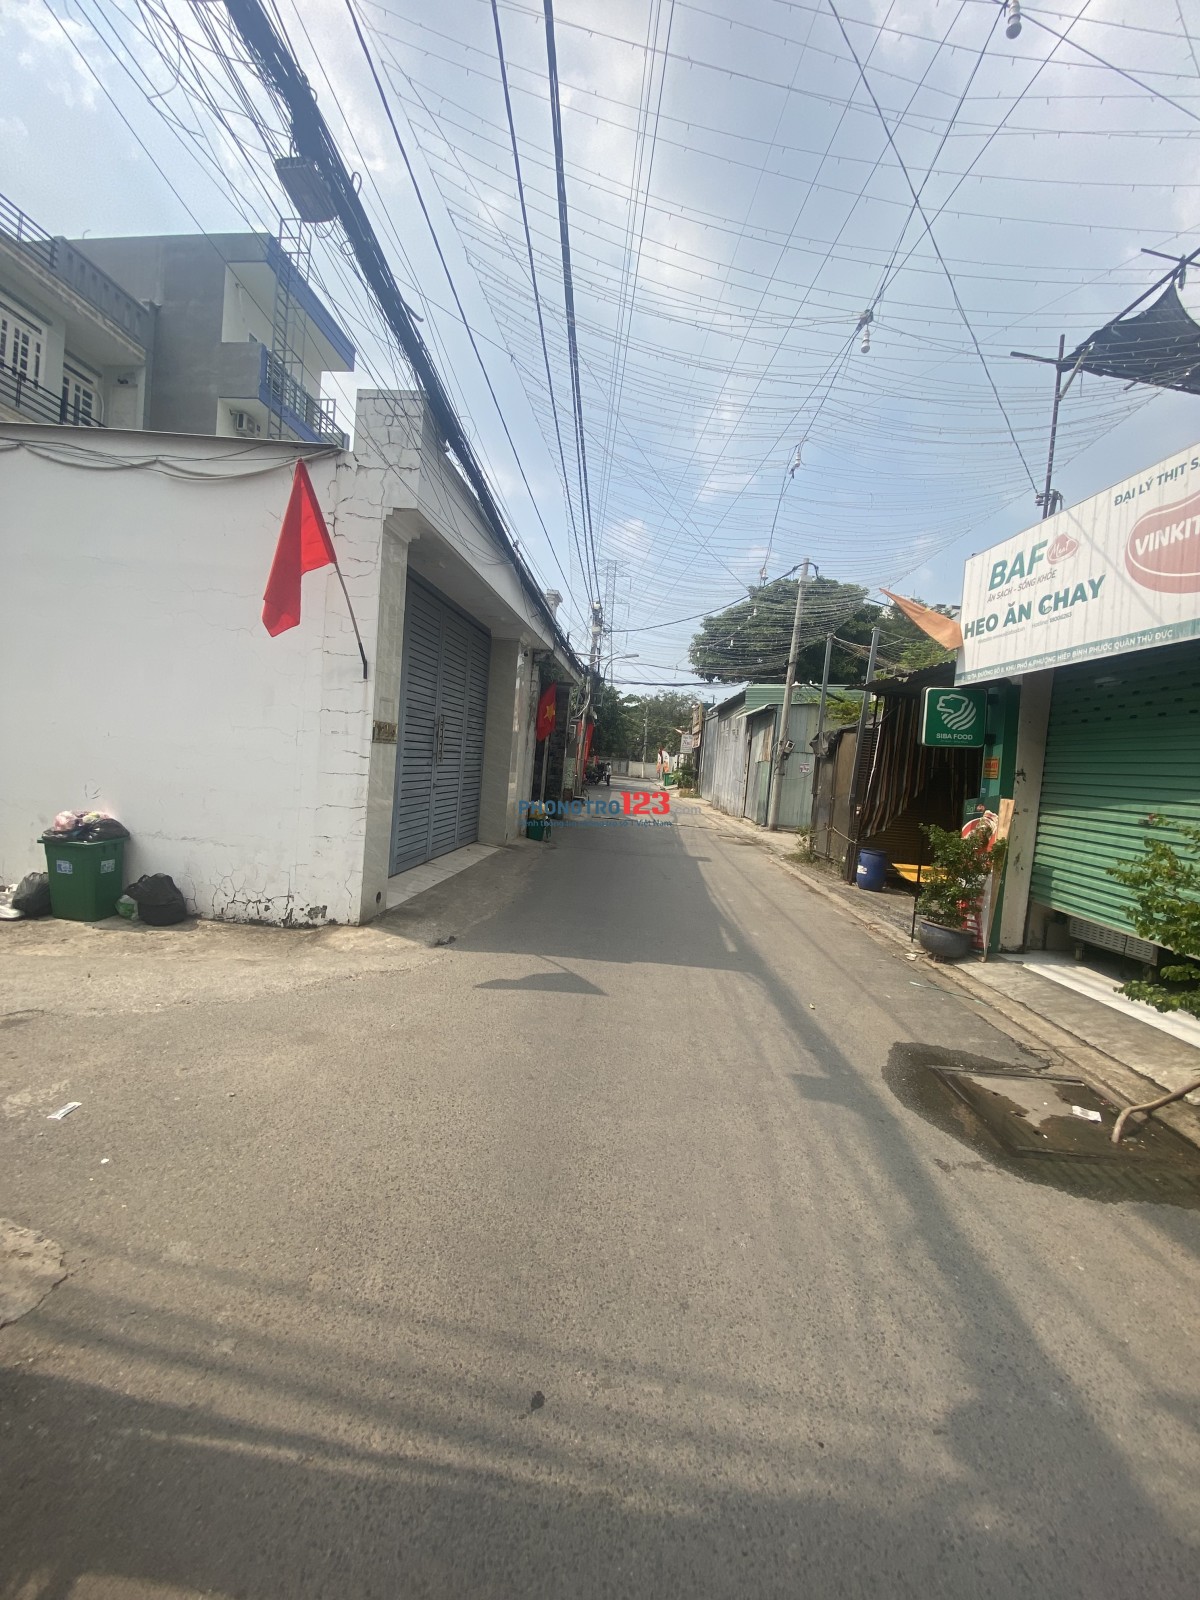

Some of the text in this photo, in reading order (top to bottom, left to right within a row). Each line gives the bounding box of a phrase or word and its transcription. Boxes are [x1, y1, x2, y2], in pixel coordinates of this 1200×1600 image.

[1114, 456, 1200, 506] ĐẠI LÝ THỊT S
[988, 539, 1049, 592] BAF
[964, 613, 999, 640] HEO
[1003, 601, 1033, 628] ĂN
[1038, 574, 1106, 616] CHAY
[1137, 631, 1153, 645] THỦ
